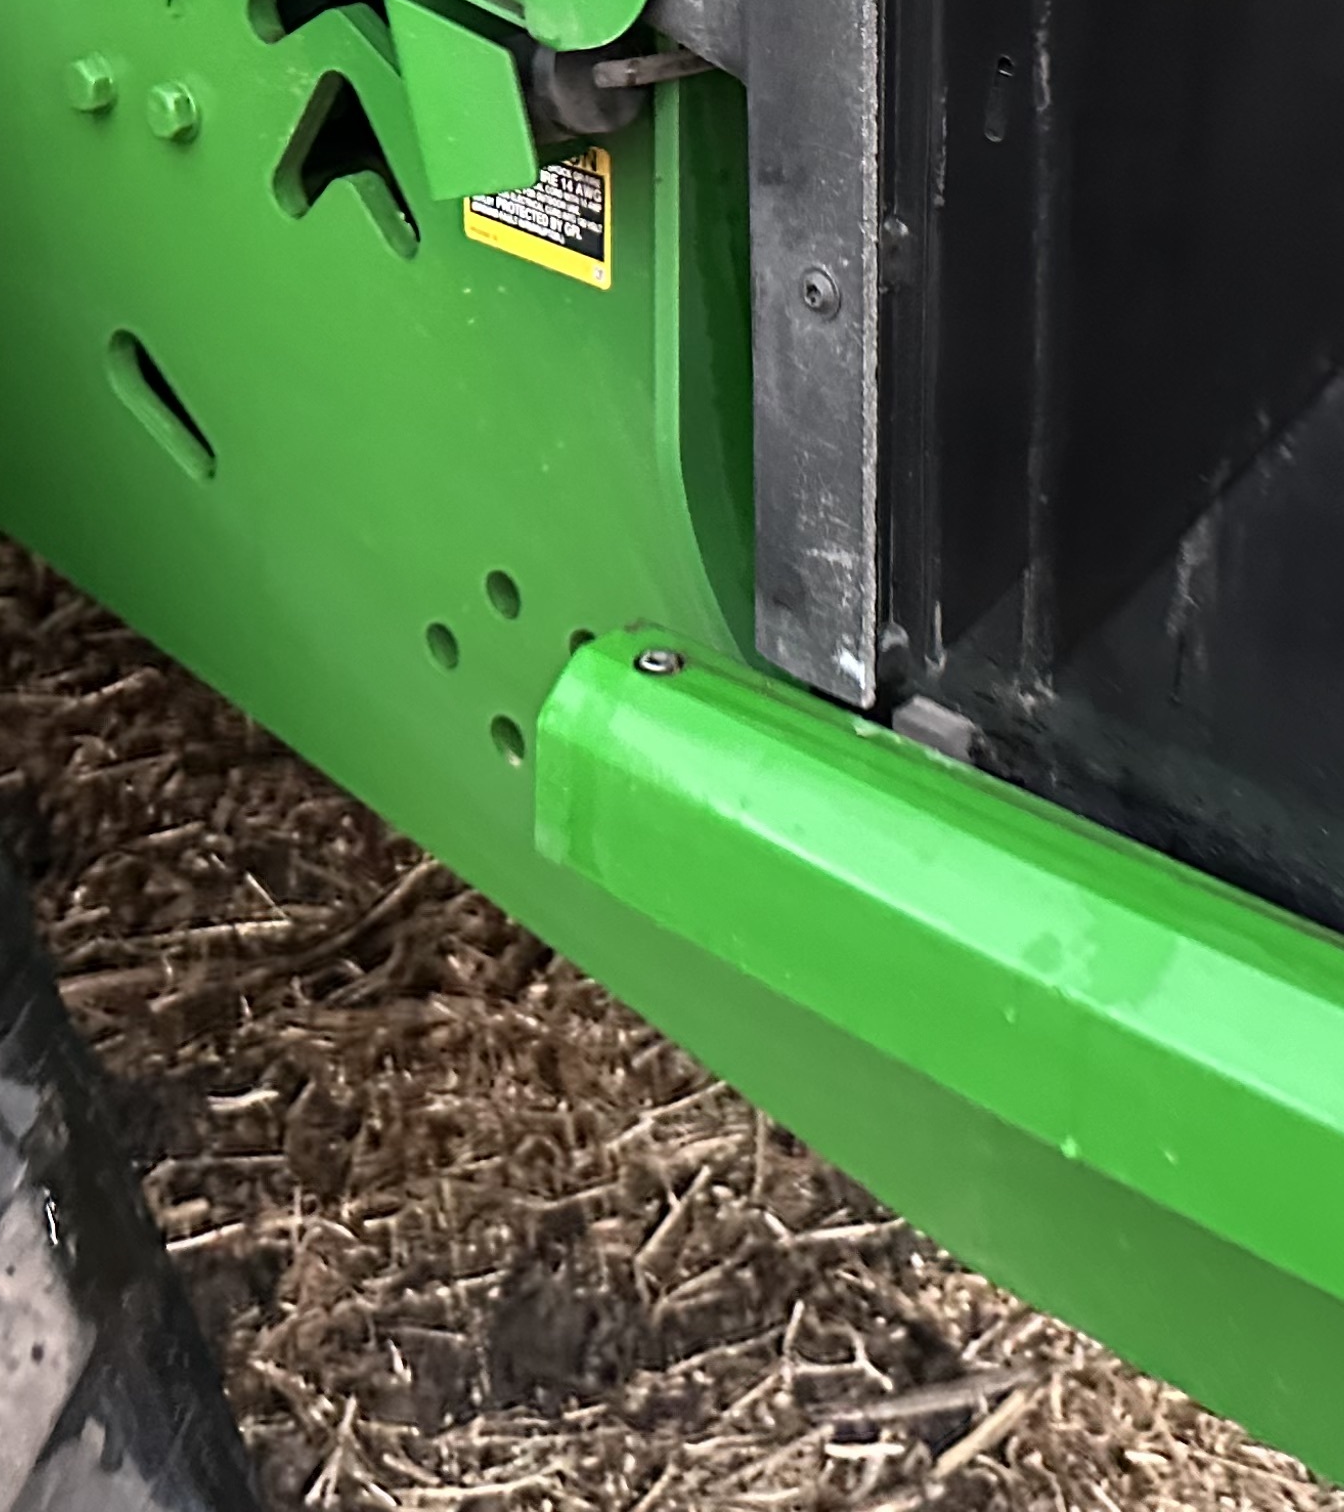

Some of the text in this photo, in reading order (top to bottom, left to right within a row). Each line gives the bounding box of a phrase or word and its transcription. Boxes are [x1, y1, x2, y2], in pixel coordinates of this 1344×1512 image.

[540, 169, 559, 188] IRE
[560, 177, 574, 193] 14
[575, 182, 603, 204] AWG
[495, 195, 549, 228] PROTECTED
[549, 216, 563, 233] BY
